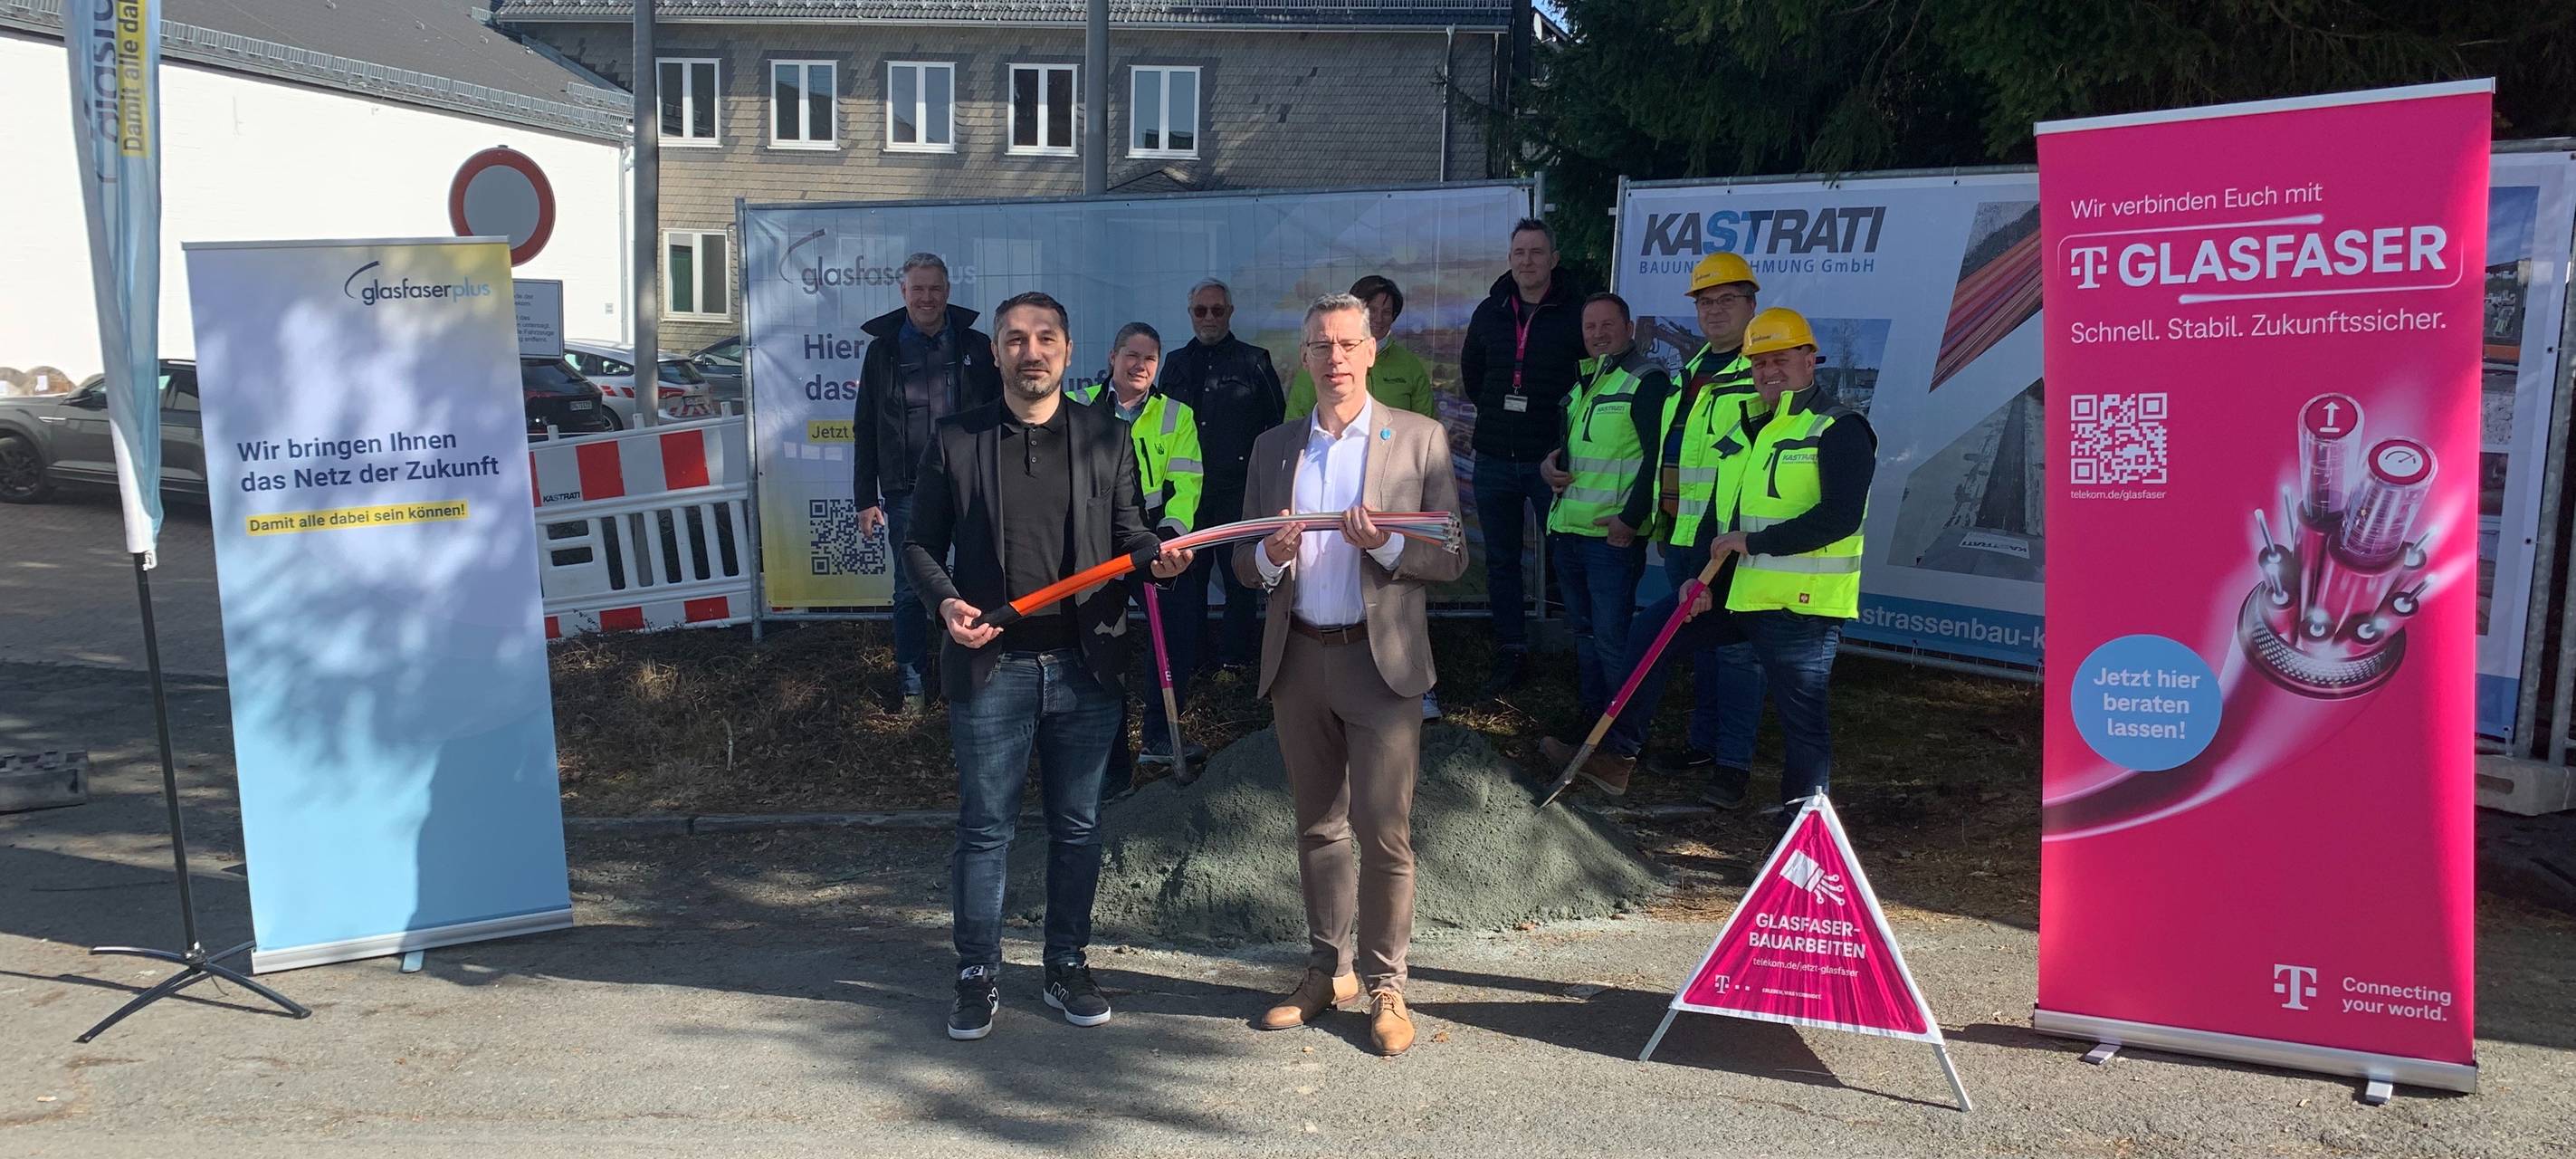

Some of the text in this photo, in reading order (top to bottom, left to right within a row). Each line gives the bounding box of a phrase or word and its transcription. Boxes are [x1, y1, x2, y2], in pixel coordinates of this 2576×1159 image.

[119, 0, 144, 151] Damit alle da
[2071, 182, 2323, 218] Wir verbinden Euch mit
[1640, 206, 1886, 255] KASTRATI
[1639, 258, 1875, 273] BAUUNHMUNG GmbH
[2119, 225, 2447, 287] GLASFASER
[362, 276, 491, 306] glasfaserplus
[2071, 308, 2447, 344] Schnell. Stabil. Zukunftssicher.
[804, 333, 864, 359] Hier
[806, 374, 857, 400] das
[812, 426, 849, 439] Jetzt
[237, 432, 457, 462] Wir bringen Ihnen
[241, 455, 500, 492] das Netz der Zukunft
[543, 492, 580, 503] KASTRATI
[2071, 490, 2166, 501] telekom.de/glasfaser
[250, 504, 465, 532] Damit alle dabei sein können!
[2094, 667, 2200, 688] Jetzt hier
[2104, 693, 2190, 714] beraten
[2107, 718, 2185, 739] lassen!
[1756, 913, 1861, 937] GLASFASER-
[1749, 933, 1866, 959] BAUARBEITEN
[1753, 957, 1859, 978] telekom.de/jetzt-glasfaser
[2342, 977, 2452, 1006] Connecting
[2342, 999, 2447, 1021] your world.
